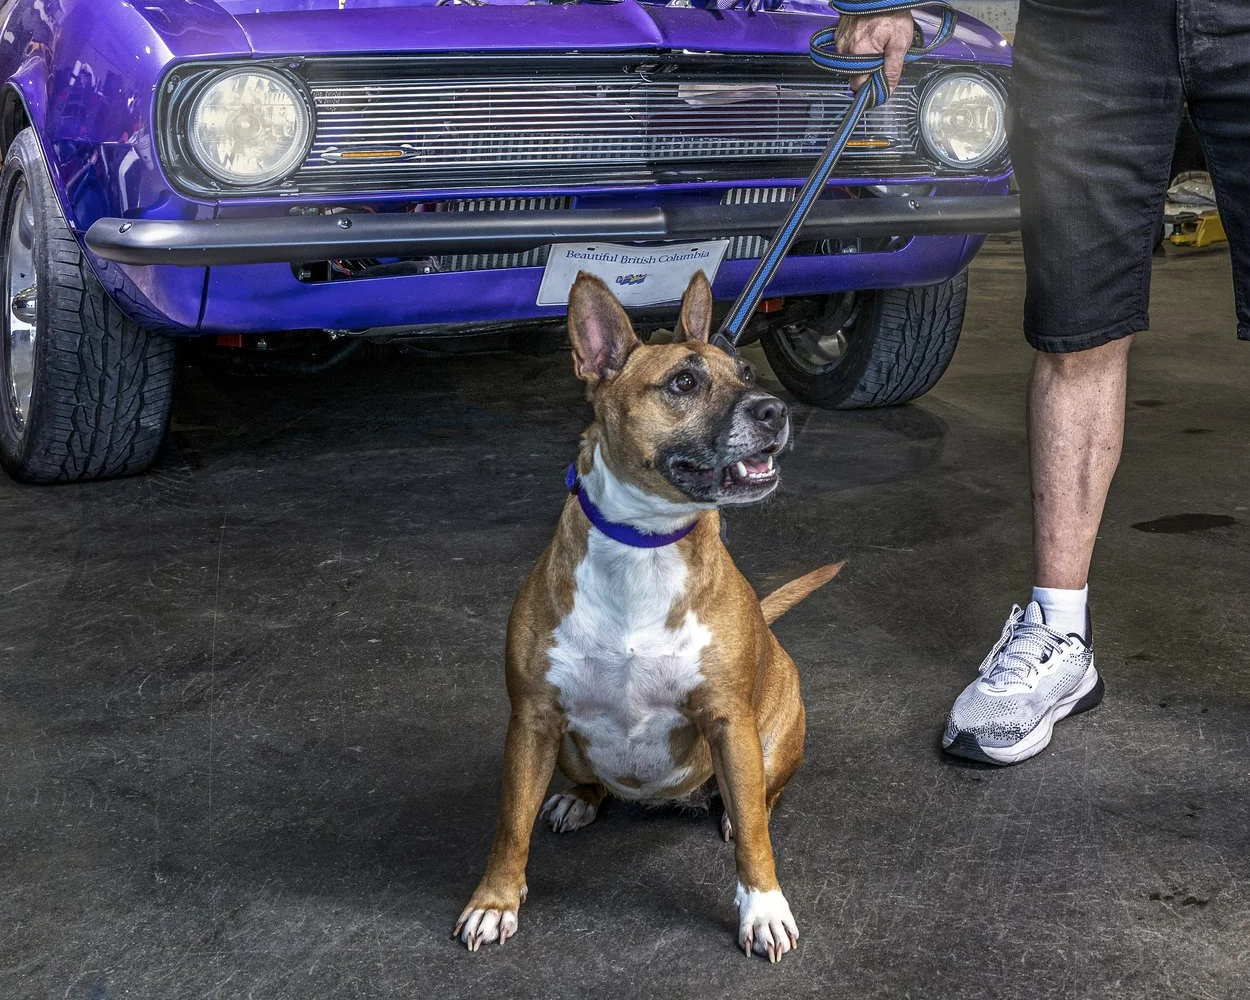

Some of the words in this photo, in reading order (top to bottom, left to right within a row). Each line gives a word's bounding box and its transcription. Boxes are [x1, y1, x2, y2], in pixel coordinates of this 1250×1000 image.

[566, 250, 617, 263] Beautiful
[620, 255, 656, 265] British
[658, 250, 710, 263] Columbia
